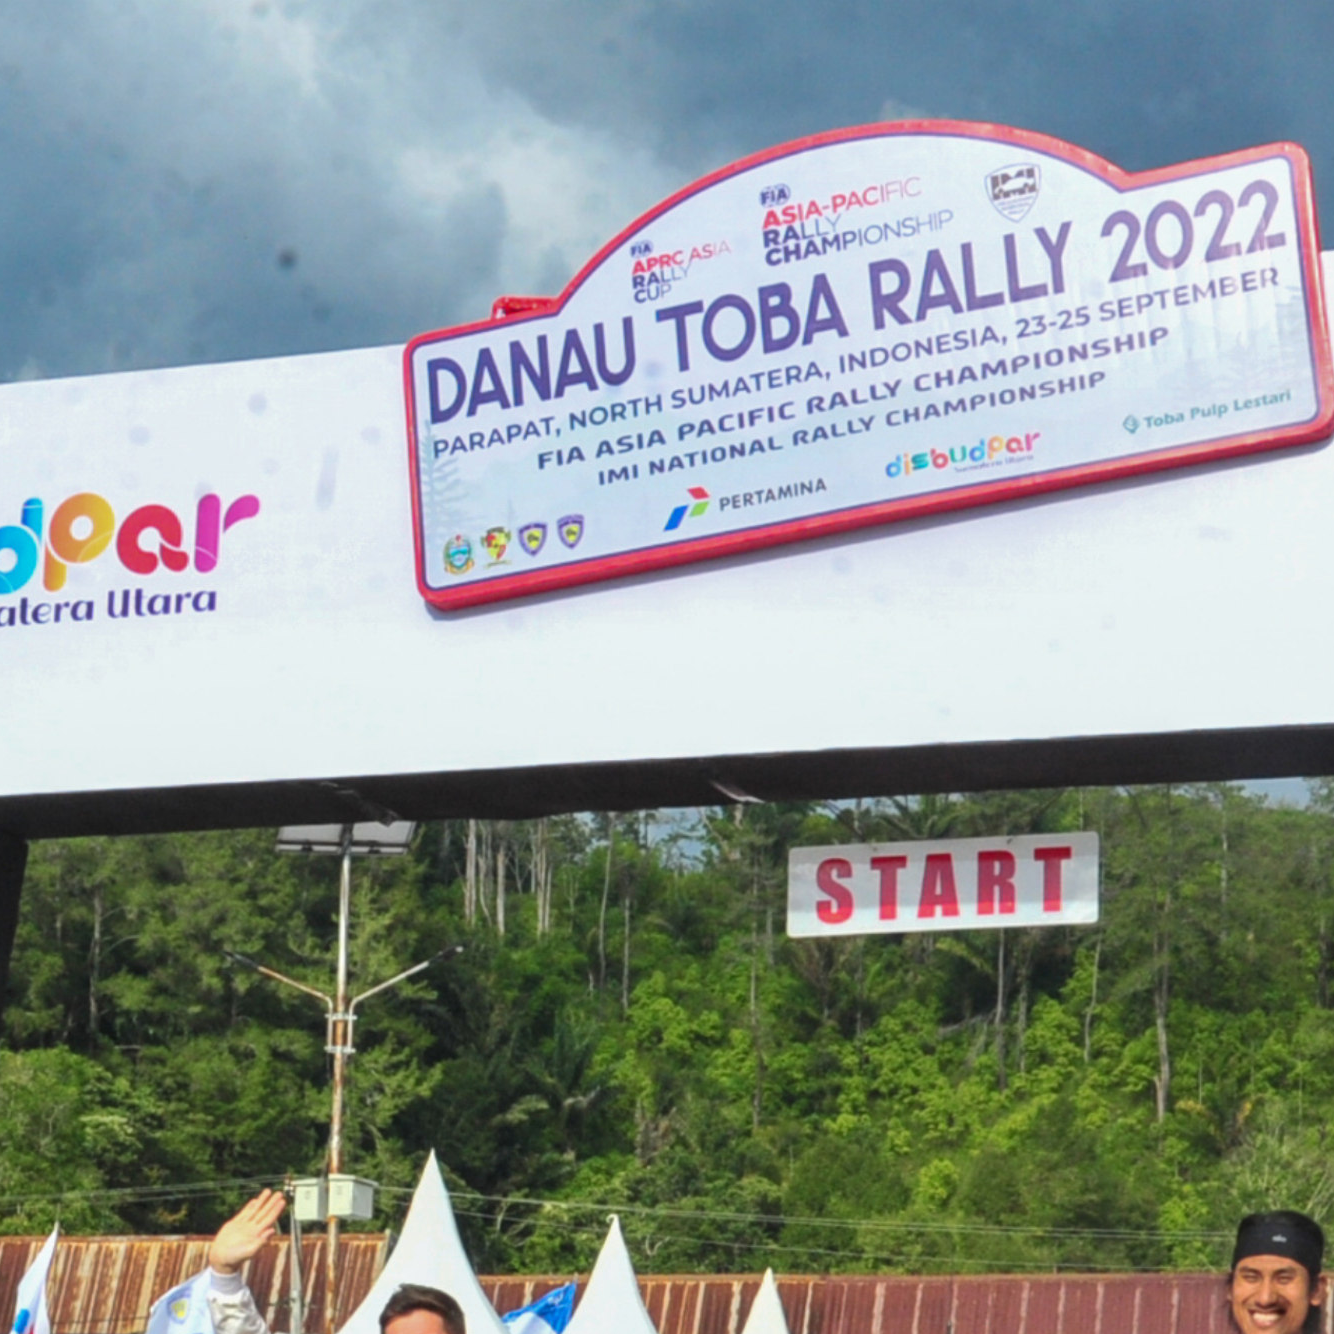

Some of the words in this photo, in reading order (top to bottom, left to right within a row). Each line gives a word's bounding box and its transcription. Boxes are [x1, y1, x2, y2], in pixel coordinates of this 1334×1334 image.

[761, 176, 922, 230] ASIA-PACIFIC
[763, 214, 842, 249] RALLY
[631, 250, 685, 275] APRC
[690, 239, 732, 262] ASIA
[765, 208, 954, 267] CHAMPIONSHIP
[427, 315, 637, 425] DANAU
[655, 273, 849, 372] TOBA
[867, 220, 1073, 331] RALLY
[1100, 179, 1287, 284] 2022
[632, 263, 691, 289] RALLY
[634, 281, 673, 304] CUP
[433, 416, 561, 459] PARAPAT,
[568, 394, 664, 431] NORTH
[670, 360, 831, 411] SUMATERA,
[839, 326, 1008, 374] INDONESIA,
[1015, 306, 1092, 340] 23-25
[1098, 266, 1280, 323] SEPTEMBER
[537, 446, 586, 471] FIA
[595, 429, 667, 459] ASIA
[677, 401, 796, 441] PACIFIC
[806, 379, 902, 415] RALLY
[913, 326, 1170, 392] CHAMPIONSHIP
[598, 464, 639, 486] IMI
[648, 435, 784, 477] NATIONAL
[792, 414, 876, 448] RALLY
[885, 370, 1107, 428] CHAMPIONSHIP
[719, 478, 827, 512] PERTAMINA
[885, 431, 1041, 479] disbudpar
[1143, 411, 1185, 430] Toba
[1190, 402, 1229, 425] Pulp
[1233, 389, 1292, 413] Lestari
[107, 589, 218, 620] Utara
[815, 846, 1072, 924] START
